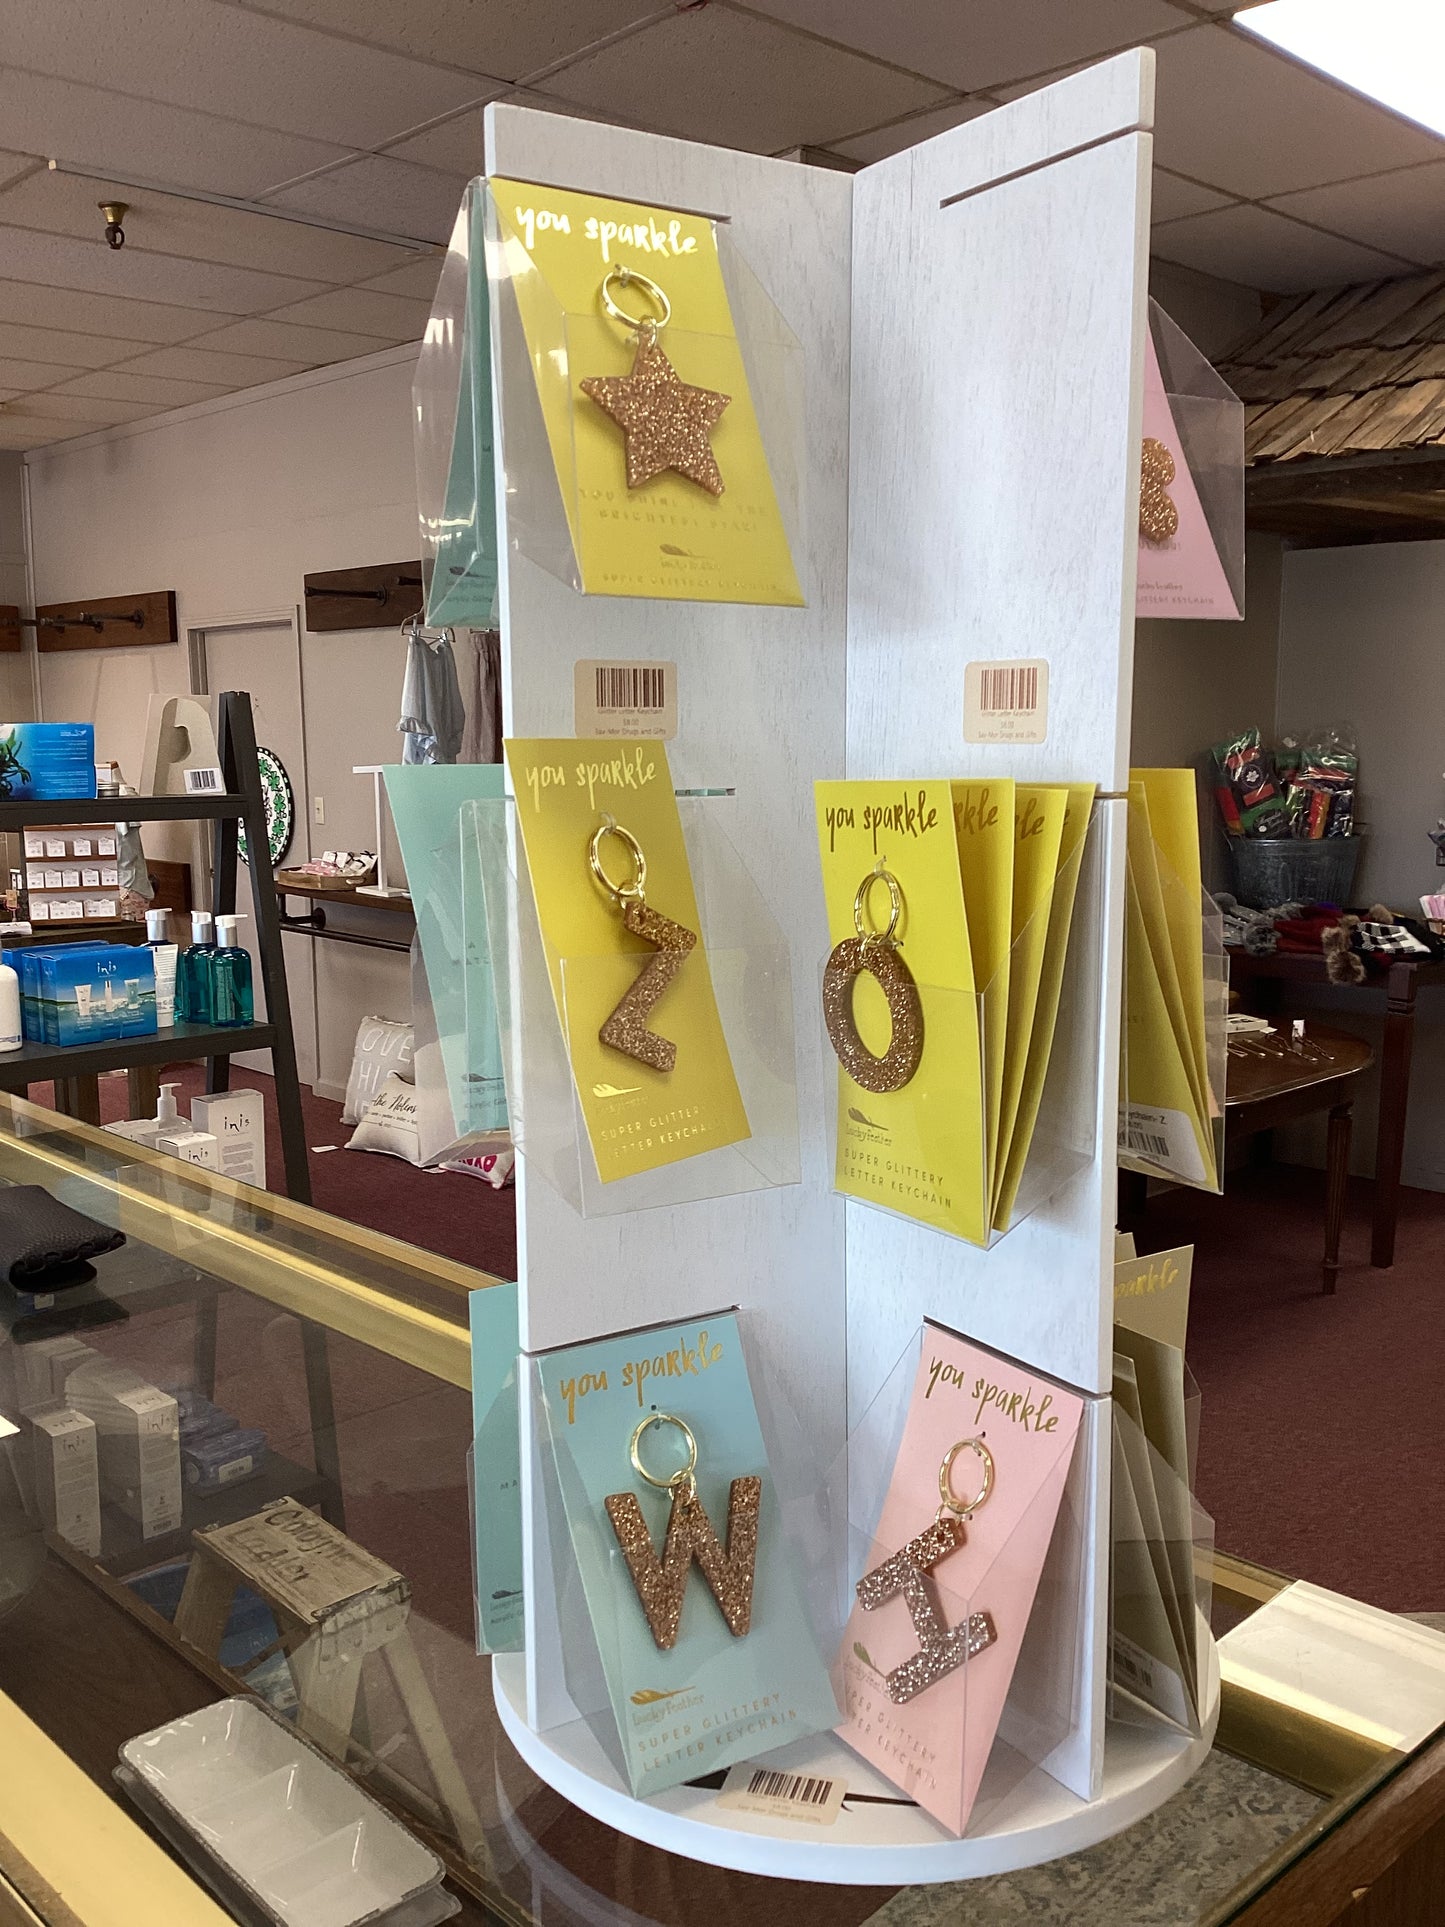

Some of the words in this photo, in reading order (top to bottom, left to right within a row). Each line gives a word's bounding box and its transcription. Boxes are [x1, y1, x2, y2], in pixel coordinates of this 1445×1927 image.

[516, 206, 571, 249] you
[585, 216, 698, 263] sparkle
[525, 766, 565, 813] you
[576, 747, 657, 810] sparkle
[825, 806, 855, 852] you
[863, 790, 938, 855] sparkle
[954, 788, 999, 834] rkle
[97, 961, 117, 975] inis
[362, 1028, 415, 1064] OVE
[224, 1113, 250, 1132] inis
[601, 1121, 642, 1141] SUPER
[650, 1104, 703, 1128] GLITTER
[613, 1138, 653, 1158] ETTER
[660, 1123, 706, 1144] KEYCHA
[188, 1147, 209, 1162] inis
[844, 1148, 879, 1166] SUPER
[886, 1161, 944, 1186] GLITTERY
[844, 1166, 884, 1186] LETTER
[891, 1180, 951, 1208] KEYCHAIN
[1114, 1258, 1179, 1298] parkle
[560, 1371, 608, 1424] you
[622, 1330, 723, 1407] sparkle
[925, 1356, 965, 1399] you
[971, 1378, 1059, 1432] sparkle
[638, 1726, 692, 1752] SUPER
[702, 1692, 781, 1729] GLITTERY
[643, 1743, 705, 1771] LETTER
[715, 1709, 798, 1745] KEYCHAIN
